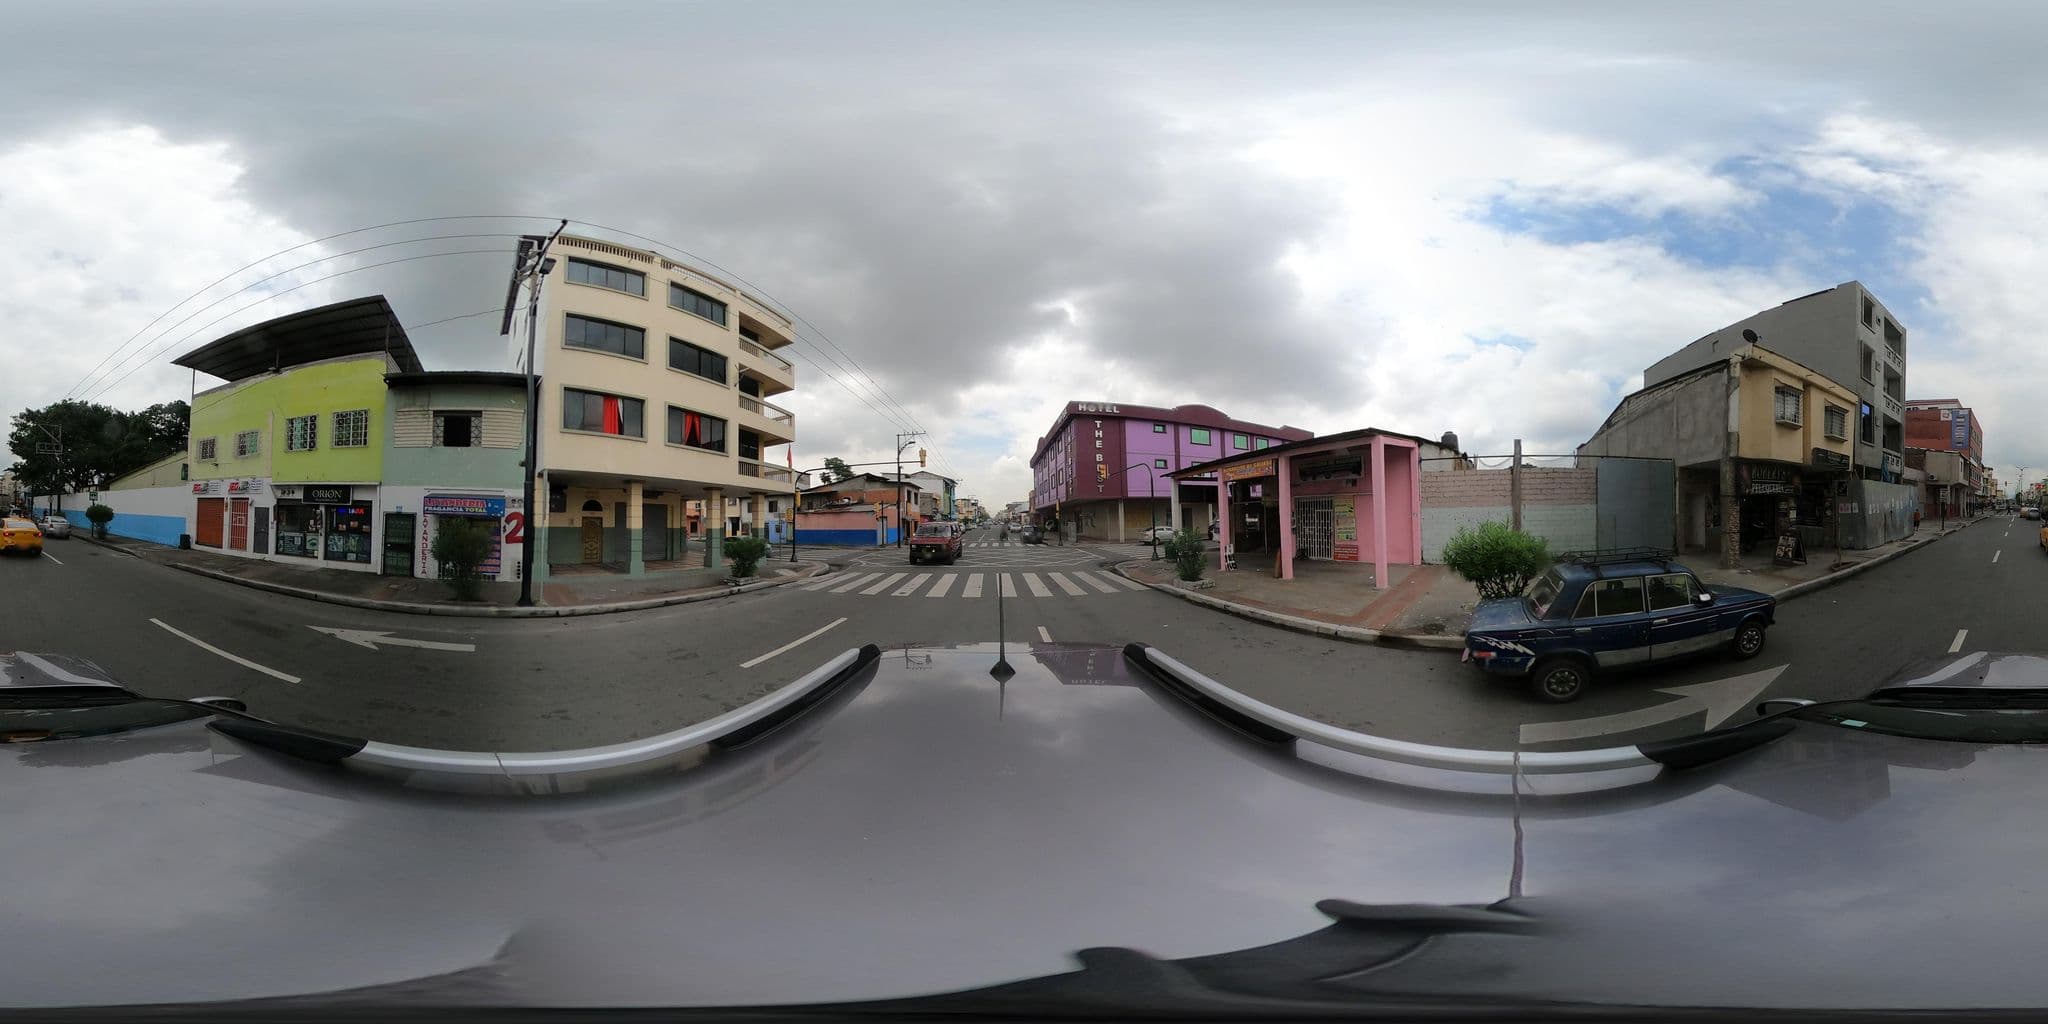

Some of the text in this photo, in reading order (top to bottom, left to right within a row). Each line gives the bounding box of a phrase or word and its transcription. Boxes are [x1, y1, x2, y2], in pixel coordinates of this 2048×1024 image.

[1078, 403, 1120, 413] HOTEL
[1094, 420, 1103, 448] THE
[312, 489, 342, 498] ORION
[421, 513, 429, 575] LAVANDERIA
